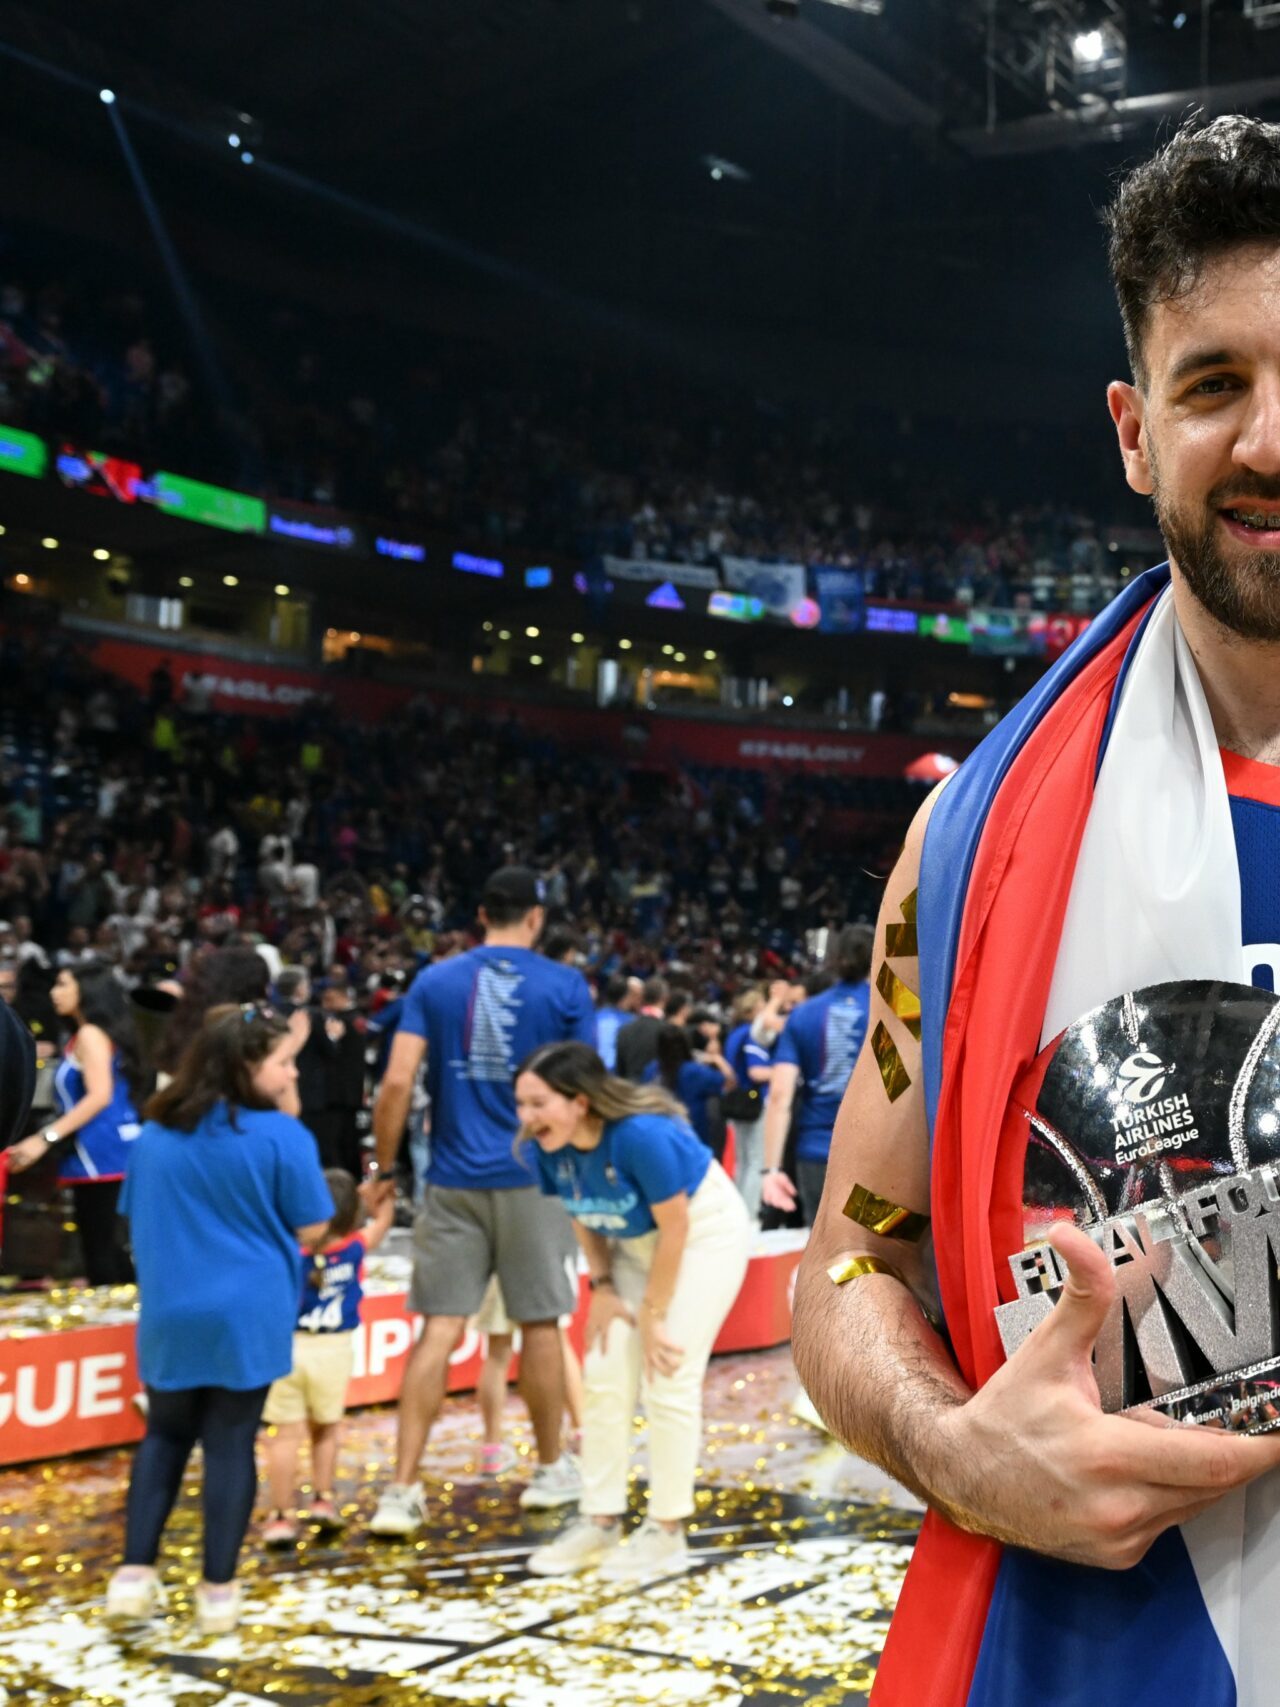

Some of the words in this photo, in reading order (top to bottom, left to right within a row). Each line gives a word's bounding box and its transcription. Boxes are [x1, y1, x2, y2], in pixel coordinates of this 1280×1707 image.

[1110, 1093, 1189, 1132] TURKISH
[1115, 1109, 1195, 1150] AIRLINES
[1115, 1128, 1199, 1165] EuroLeague
[1008, 1211, 1173, 1300] FIAL
[0, 1352, 126, 1428] UE
